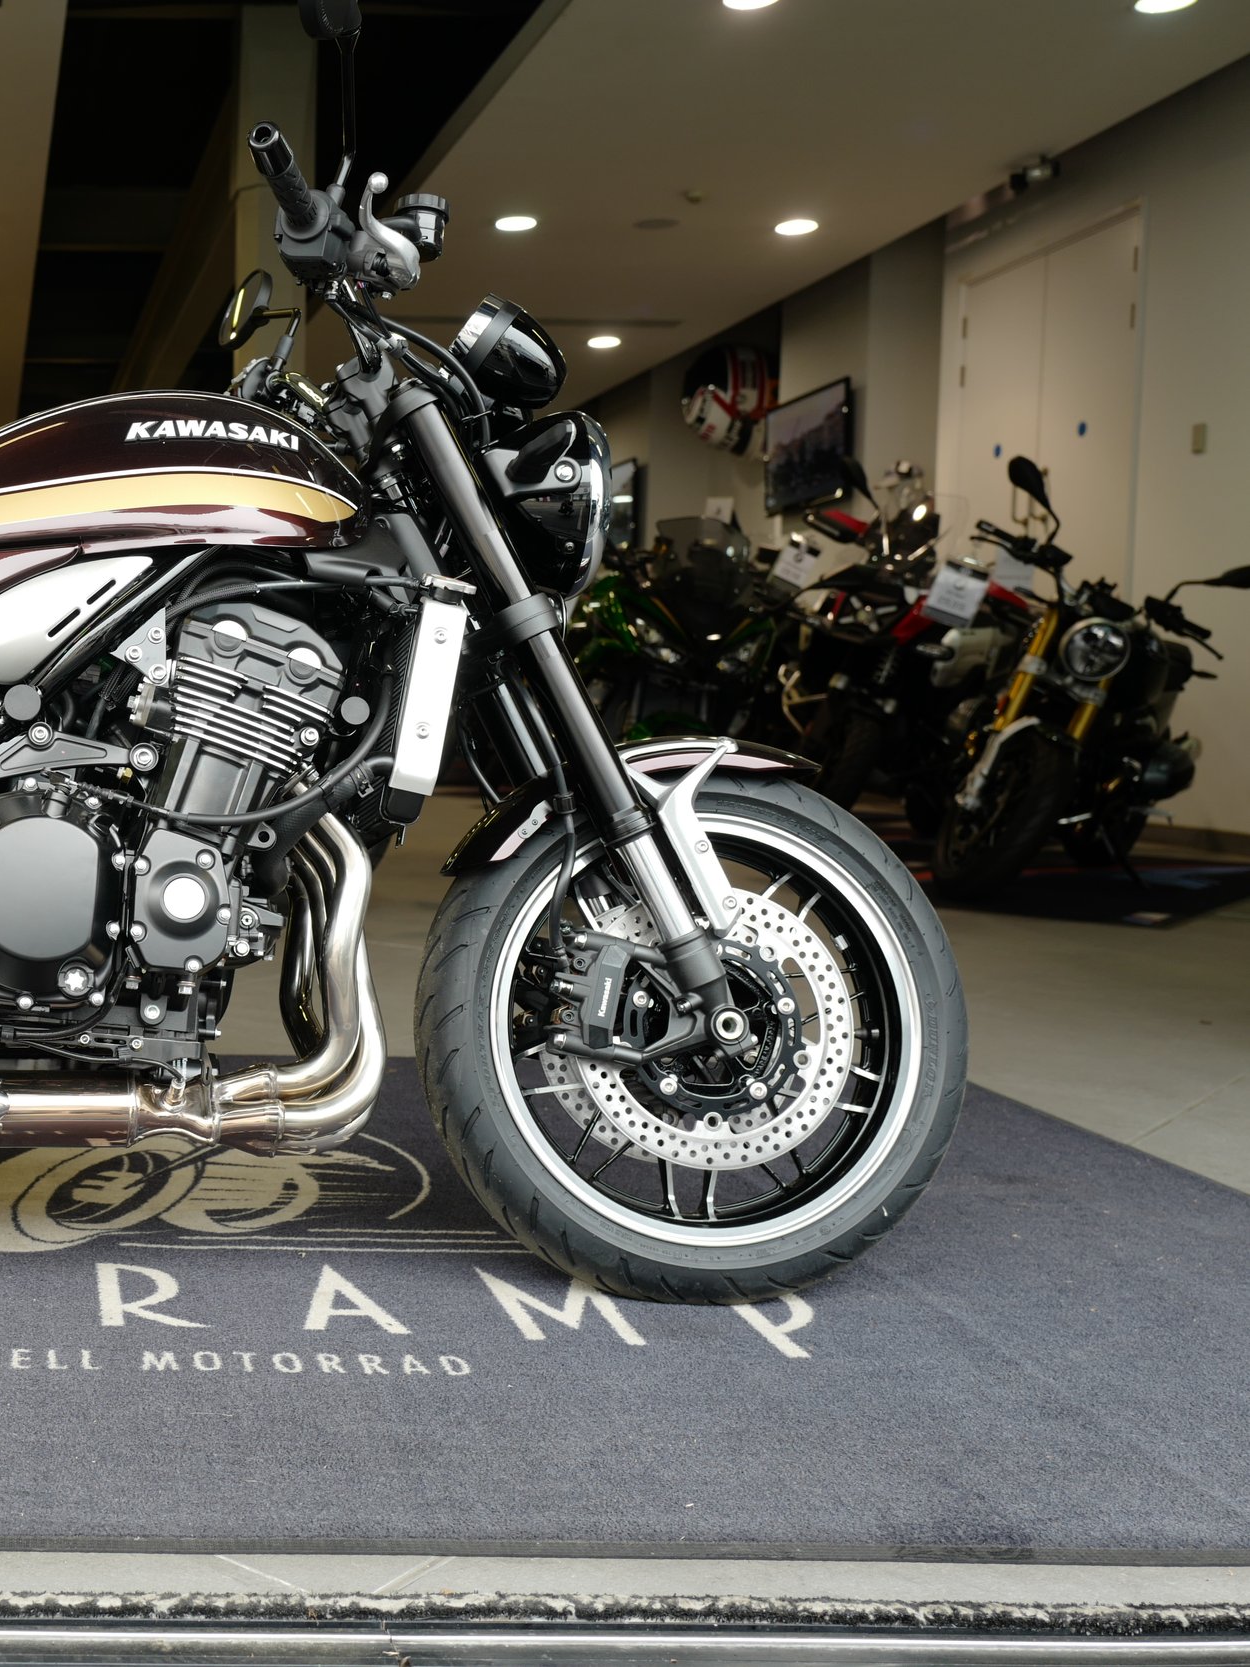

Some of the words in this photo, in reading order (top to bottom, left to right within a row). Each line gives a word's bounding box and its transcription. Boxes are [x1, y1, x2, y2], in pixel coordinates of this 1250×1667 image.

[124, 419, 299, 451] KAWASAKI
[597, 977, 612, 1018] Kawasaki
[924, 1013, 939, 1098] DUNLOP
[95, 1262, 811, 1359] RAMP
[142, 1350, 471, 1376] MOTORRAD
